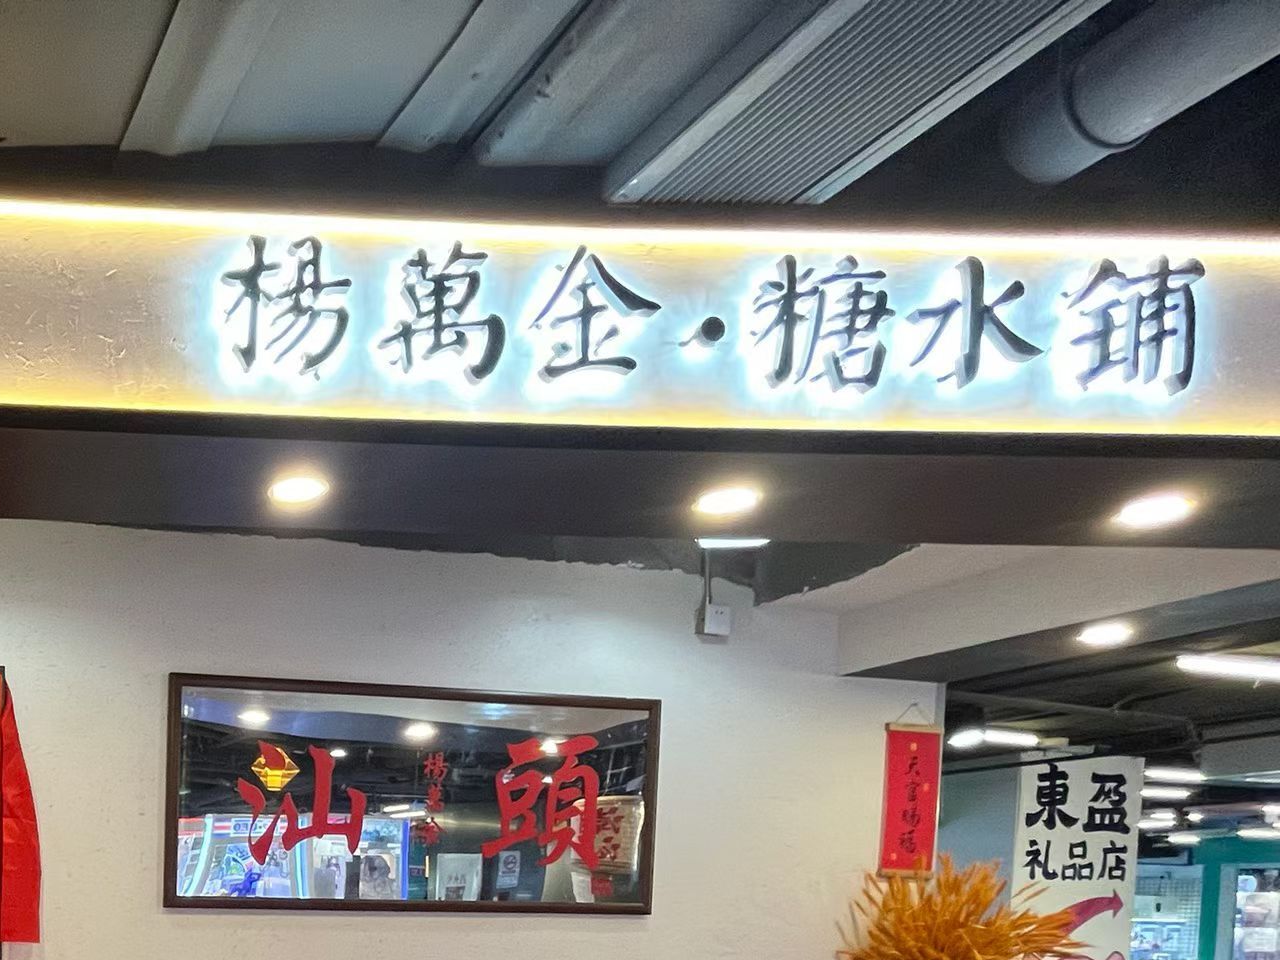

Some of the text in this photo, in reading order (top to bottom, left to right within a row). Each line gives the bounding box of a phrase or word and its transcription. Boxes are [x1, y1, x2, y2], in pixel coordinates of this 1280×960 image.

[221, 234, 1206, 397] 楊萬金·糖水鋪
[237, 740, 367, 865] 汕
[481, 734, 601, 870] 頭
[1025, 763, 1131, 834] 東盈
[1023, 839, 1128, 881] 礼品店
